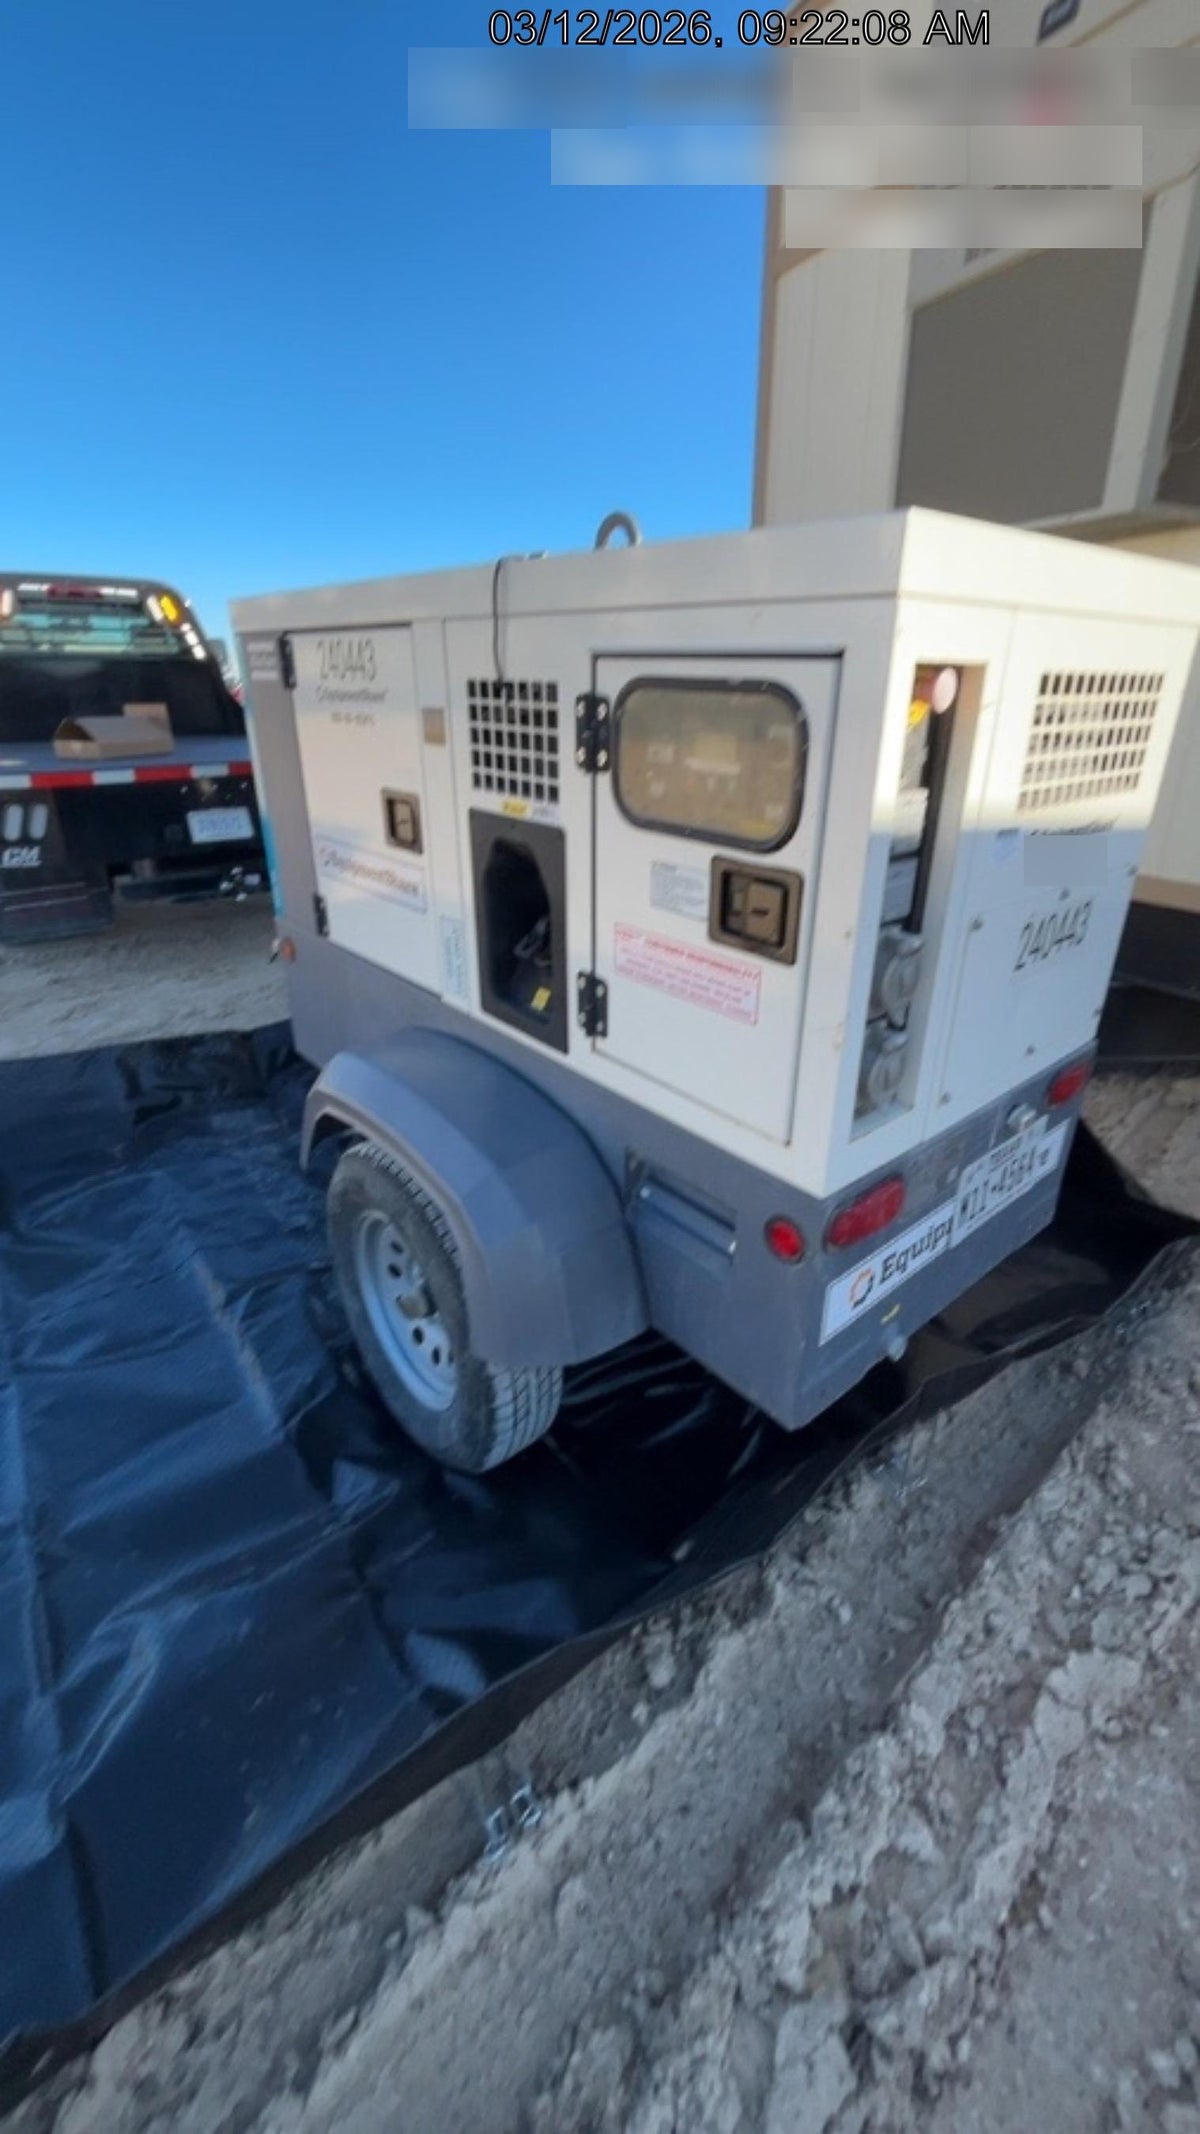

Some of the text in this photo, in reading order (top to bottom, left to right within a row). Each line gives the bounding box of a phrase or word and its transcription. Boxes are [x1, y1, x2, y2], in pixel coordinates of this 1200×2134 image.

[316, 638, 378, 682] 240443
[1012, 900, 1094, 972] 240443
[880, 1215, 953, 1284] Equip
